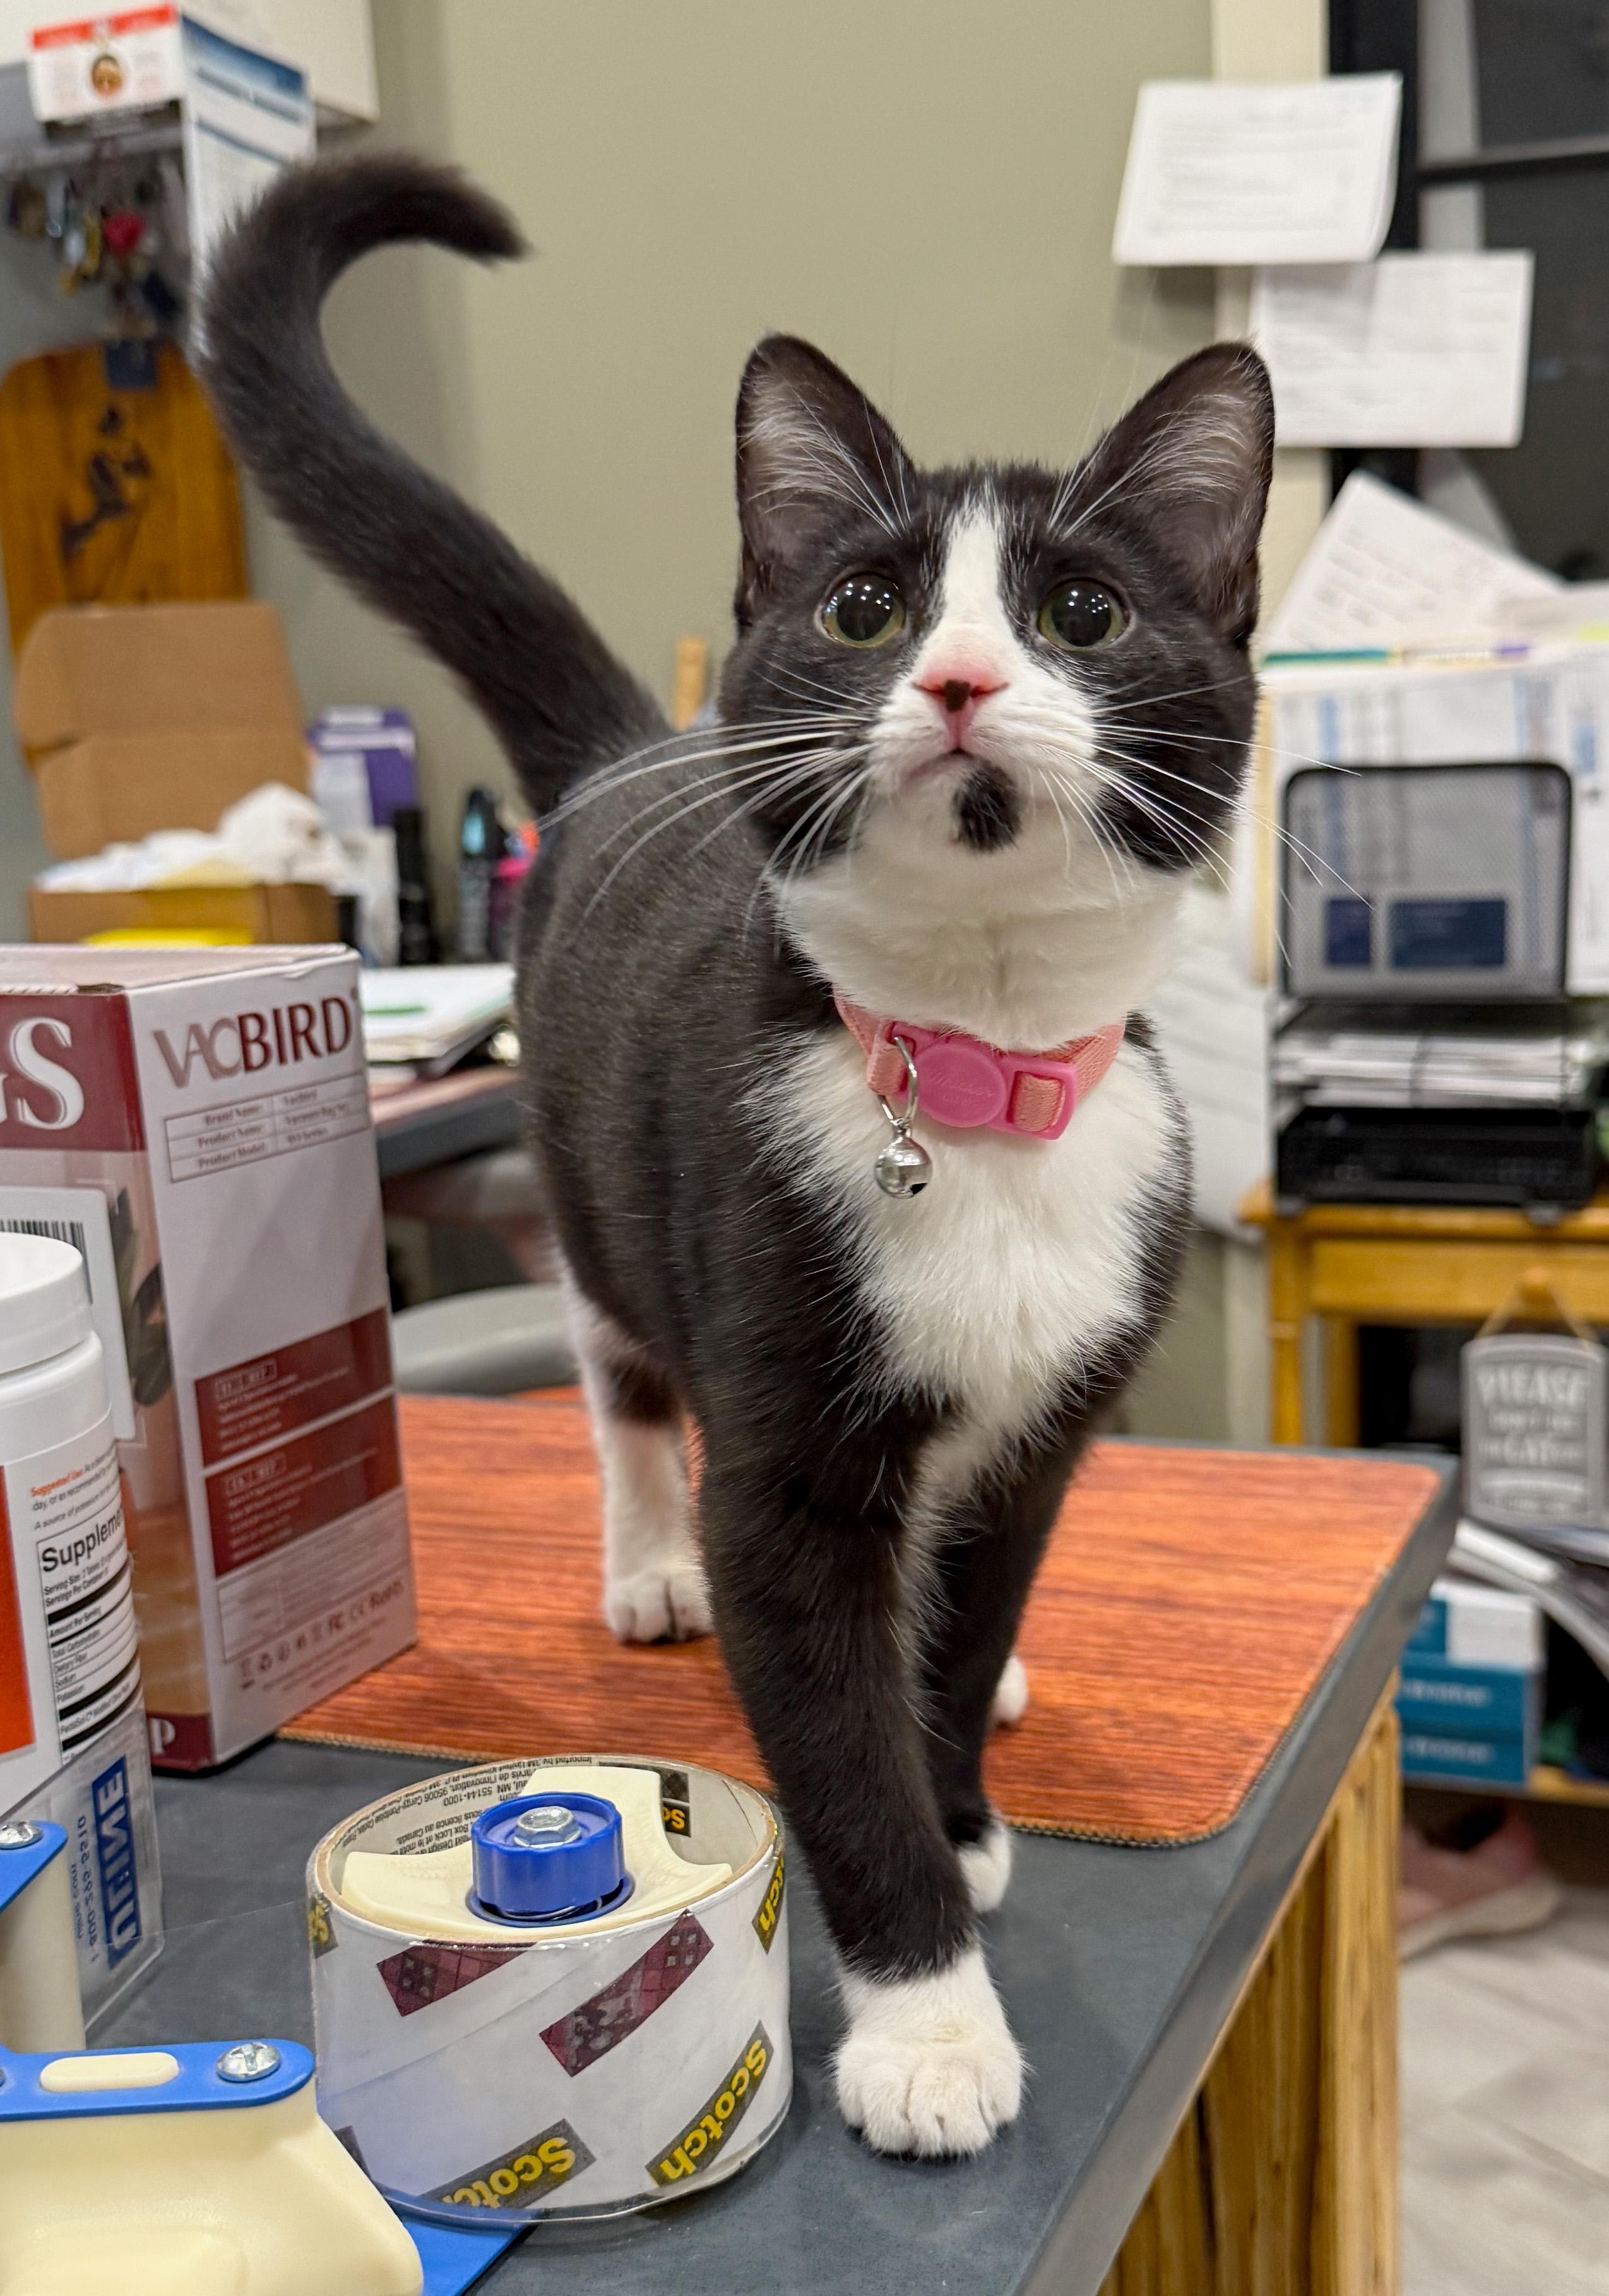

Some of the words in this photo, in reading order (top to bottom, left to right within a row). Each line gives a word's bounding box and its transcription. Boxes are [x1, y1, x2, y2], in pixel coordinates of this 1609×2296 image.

[153, 996, 353, 1089] VACBIRD
[0, 1017, 85, 1130] S
[42, 1509, 122, 1572] Suppleme
[499, 1772, 509, 1782] de
[511, 1769, 534, 1780] arvis
[497, 1783, 511, 1794] MN
[513, 1780, 528, 1790] aul,
[424, 1787, 448, 1802] 95006
[444, 1786, 492, 1806] 55144-1000
[425, 1823, 434, 1833] au
[436, 1815, 462, 1829] licence
[454, 1824, 468, 1833] Box
[396, 1828, 424, 1844] Canada.
[434, 1828, 453, 1842] Lock
[656, 2039, 768, 2182] Scotch
[442, 2137, 576, 2210] Scotc
